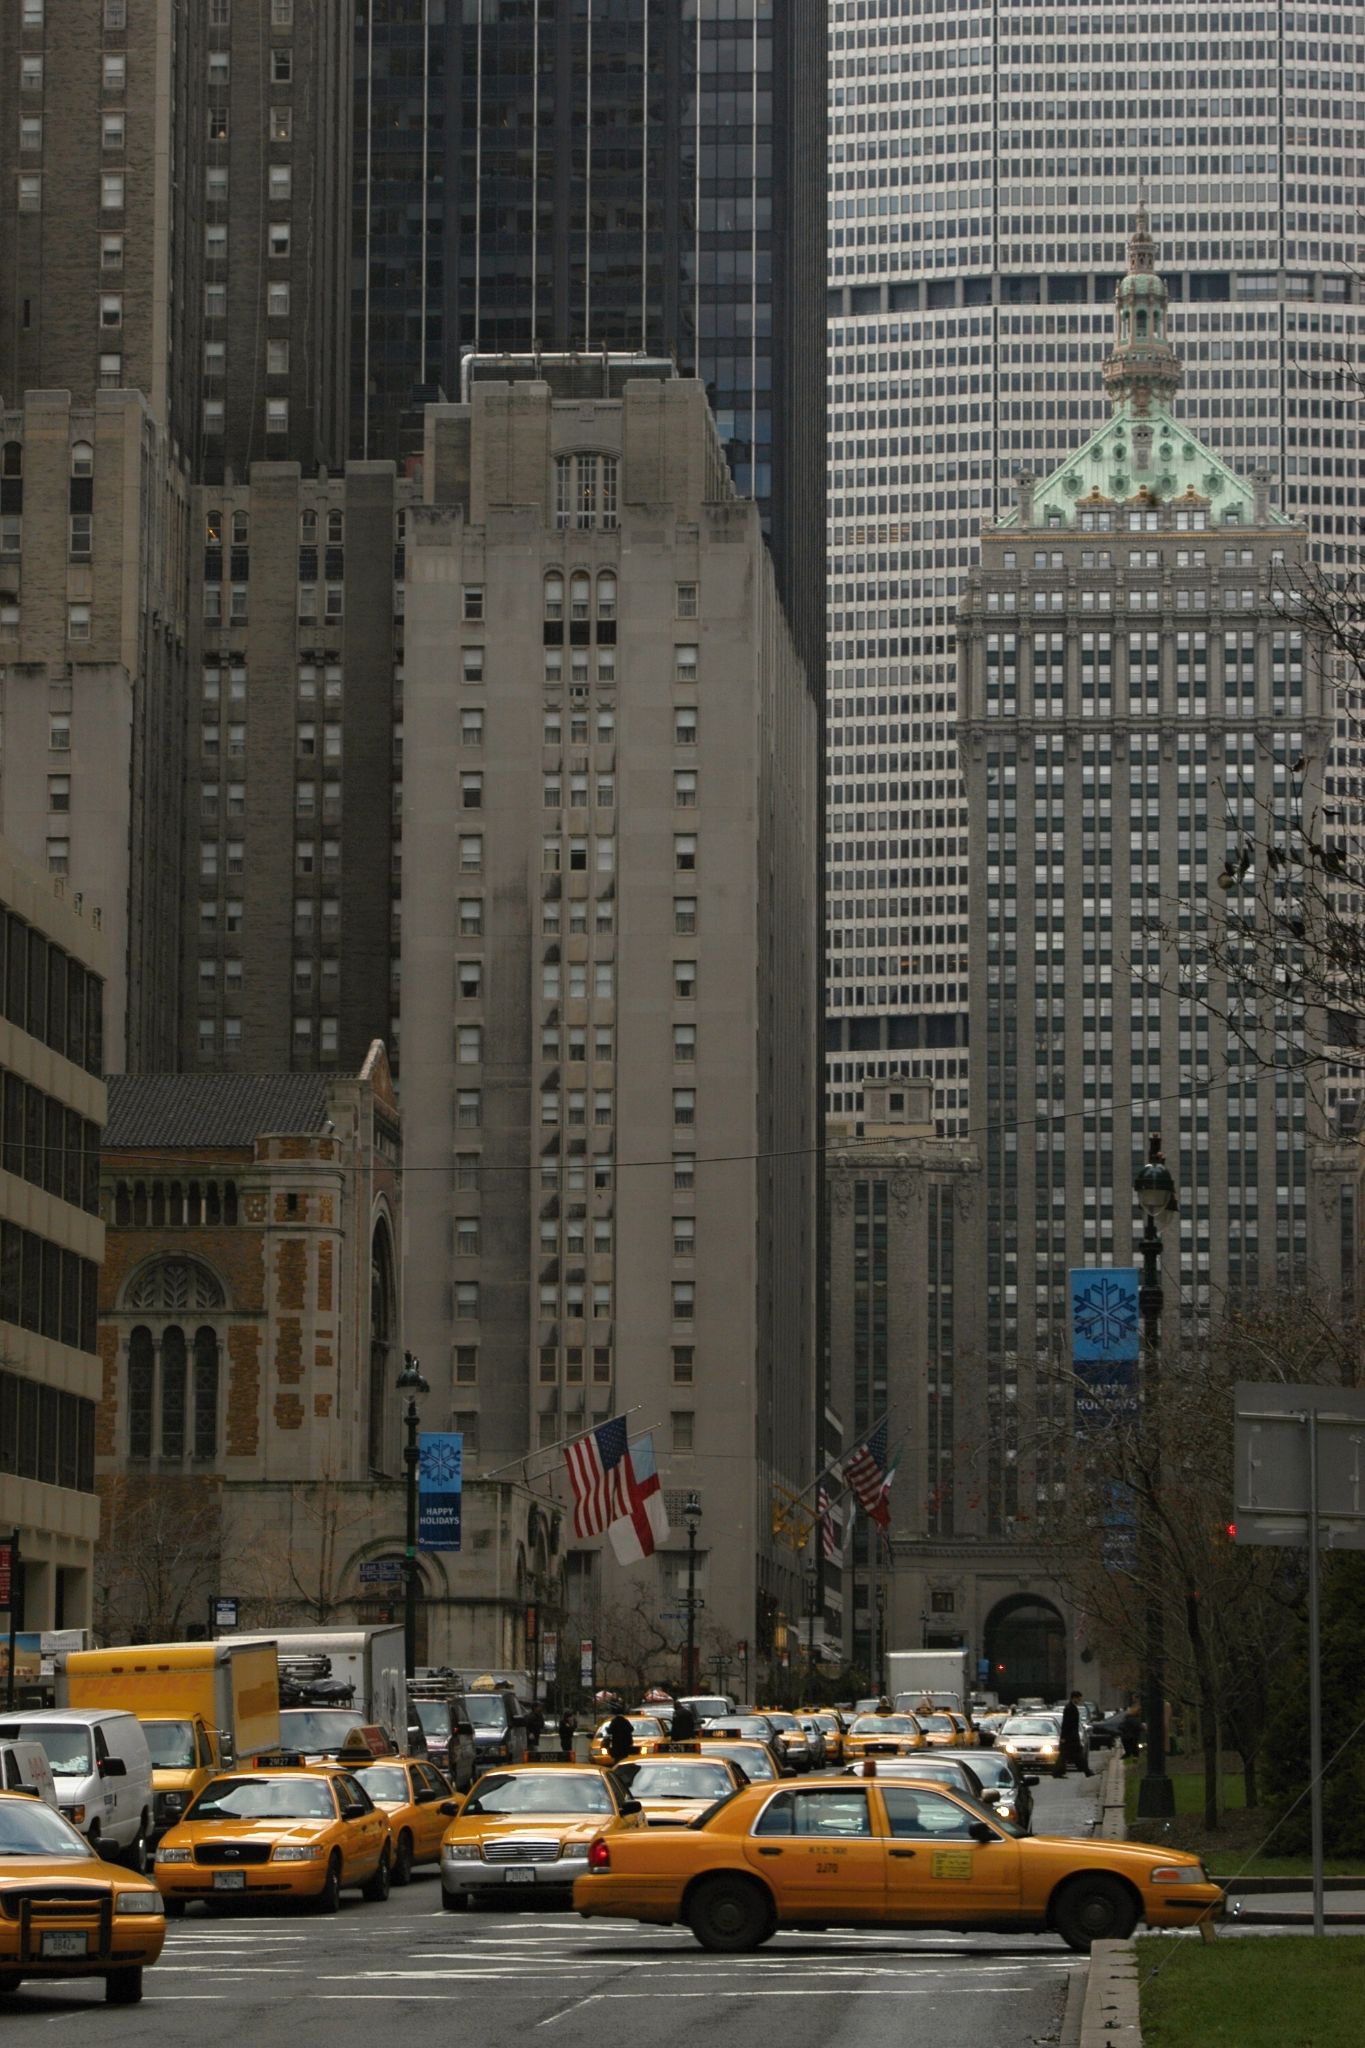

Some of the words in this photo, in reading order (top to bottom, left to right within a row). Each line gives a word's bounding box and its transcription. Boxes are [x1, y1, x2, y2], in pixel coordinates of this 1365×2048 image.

[1076, 1398, 1137, 1410] HOLDAYS
[426, 1507, 454, 1516] HAPPY
[420, 1517, 460, 1525] HOLIDAYS
[78, 1674, 204, 1698] PENSKE
[269, 1757, 289, 1766] 2M27
